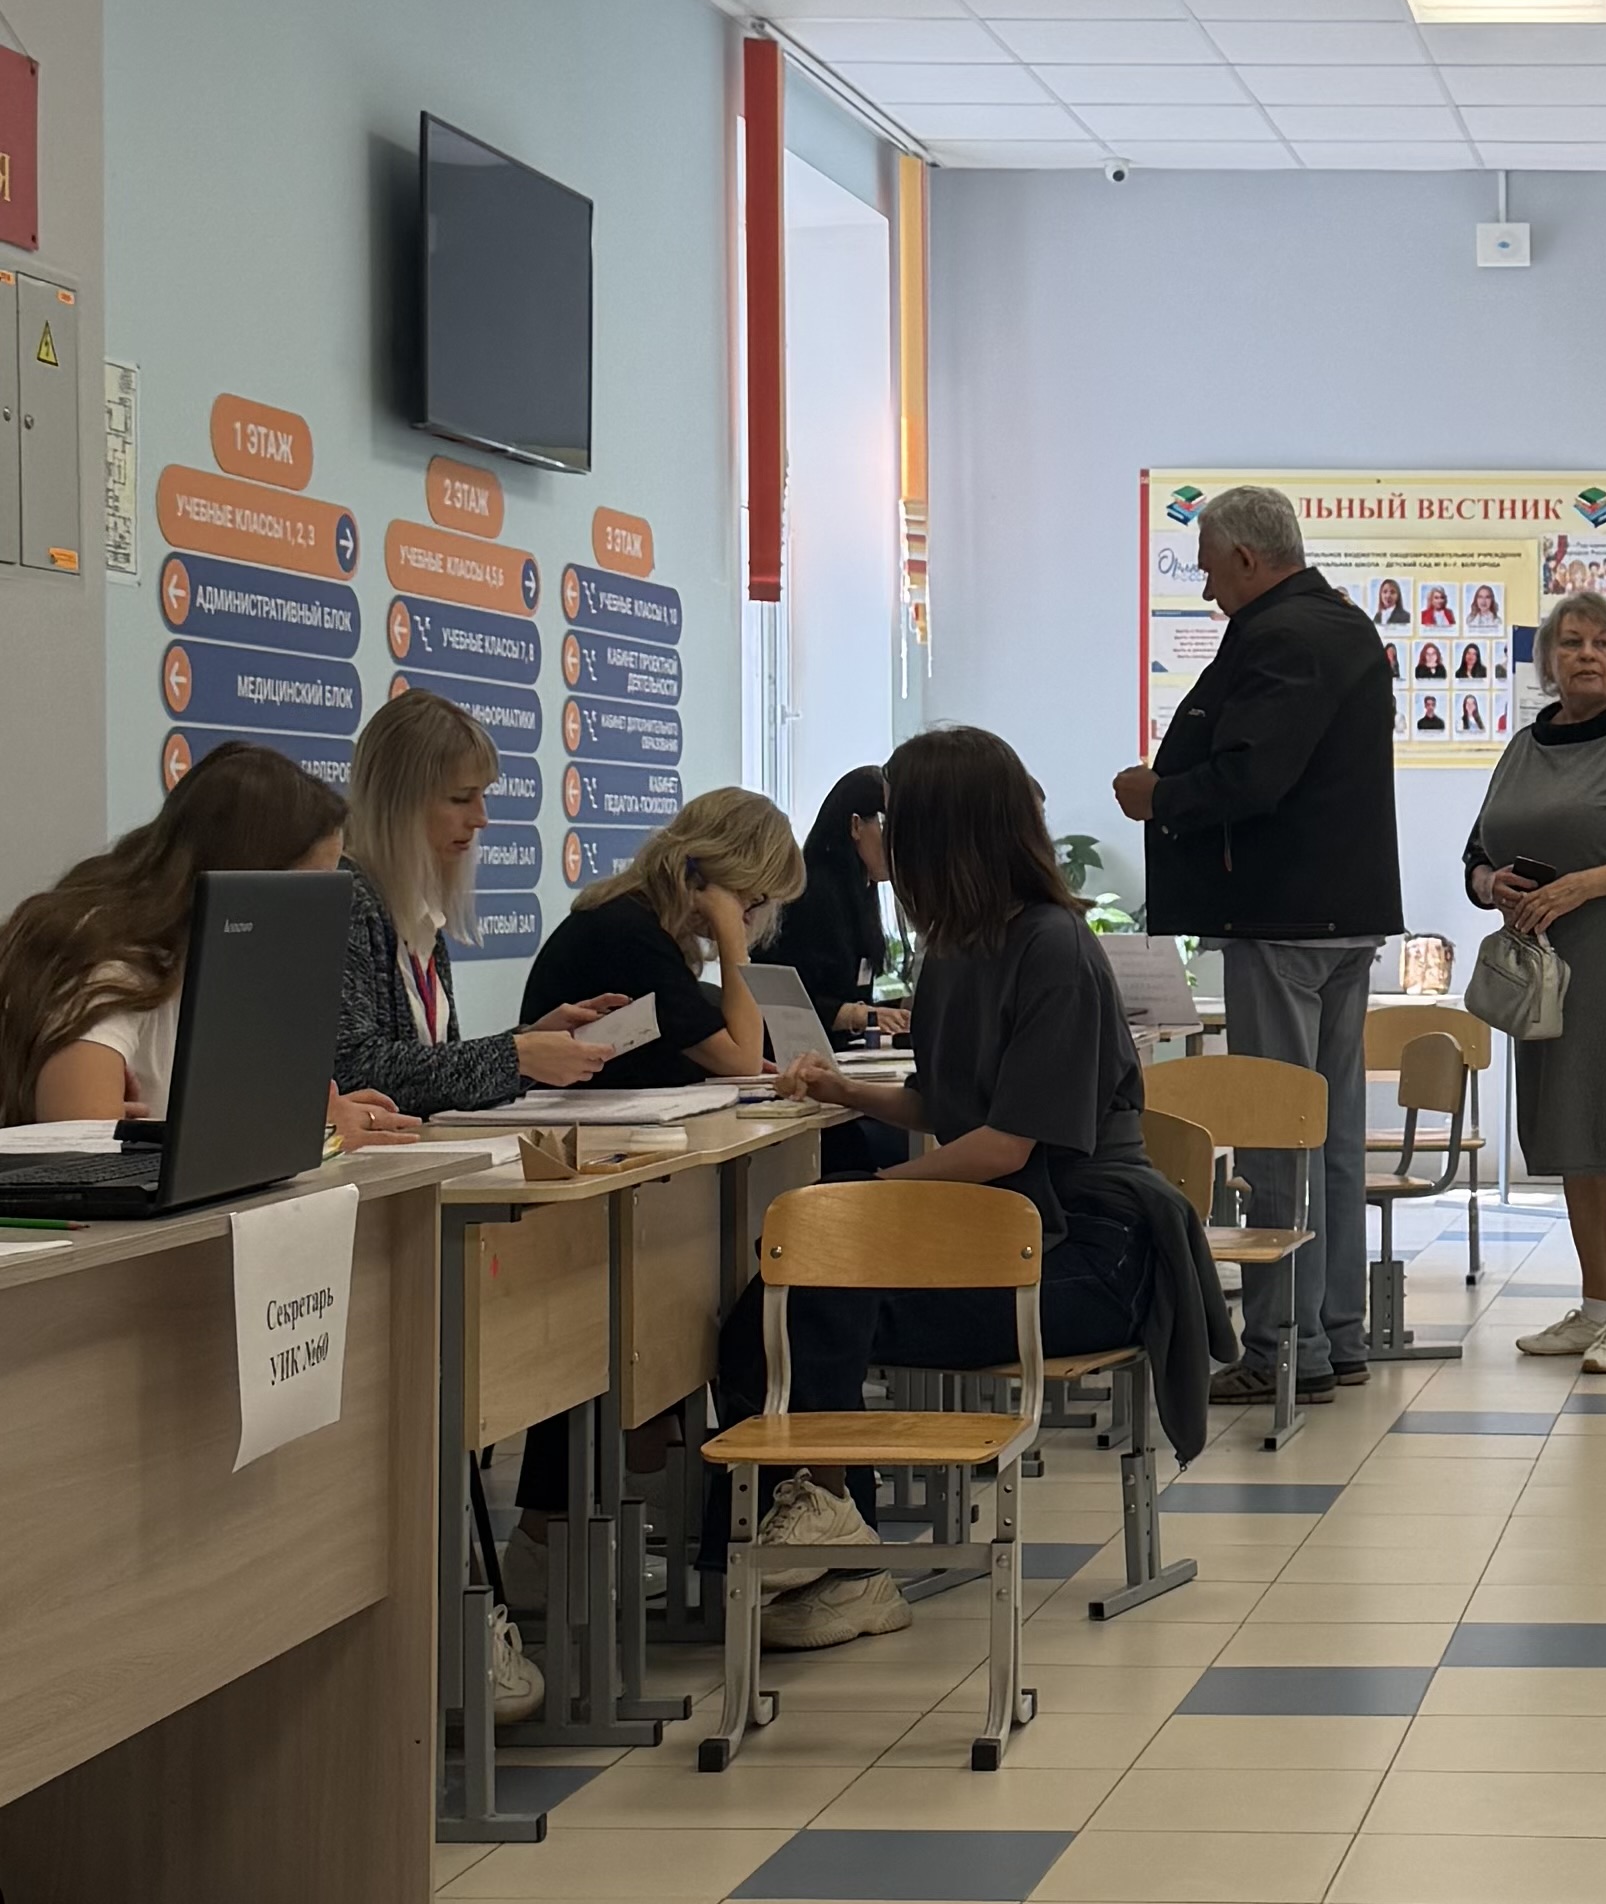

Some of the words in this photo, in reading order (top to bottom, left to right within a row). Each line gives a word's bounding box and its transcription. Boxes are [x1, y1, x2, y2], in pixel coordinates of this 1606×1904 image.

[234, 421, 242, 450] 1
[247, 424, 293, 465] ЭТАЖ
[443, 479, 452, 505] 2
[454, 482, 489, 516] ЭТАЖ
[1297, 492, 1408, 521] ЛЬНЫЙ
[1417, 497, 1564, 521] ВЕСТНИК
[176, 493, 233, 529] УЧЕБНЫЕ
[235, 510, 284, 539] КЛАССЫ
[308, 525, 316, 545] 3
[605, 526, 612, 550] 3
[614, 527, 642, 559] ЭТАЖ
[399, 544, 444, 574] УЧЕБНЫЕ
[446, 557, 484, 582] КЛАССЫ
[196, 584, 322, 627] АДМИНИСТРАТИВНЫЙ
[323, 607, 352, 632] БЛОК
[599, 591, 632, 616] УЧЕБНЫЕ
[634, 599, 662, 624] КЛАССЫ
[442, 627, 483, 653] УЧЕБНЫЕ
[484, 635, 520, 659] КЛАССЫ
[607, 646, 638, 670] КАБИНЕТ
[237, 674, 323, 706] МЕДИЦИНСКИЙ
[325, 685, 353, 709] БЛОК
[472, 704, 536, 729] ИНФОРМАТИКИ
[509, 777, 536, 798] КЛАСС
[477, 842, 517, 865] РТИВНЫЙ
[519, 846, 536, 865] ЗАЛ
[478, 911, 517, 934] АКТОВЫЙ
[519, 914, 535, 933] ЗАЛ
[266, 1286, 334, 1331] Секретарь
[269, 1344, 301, 1386] УИК
